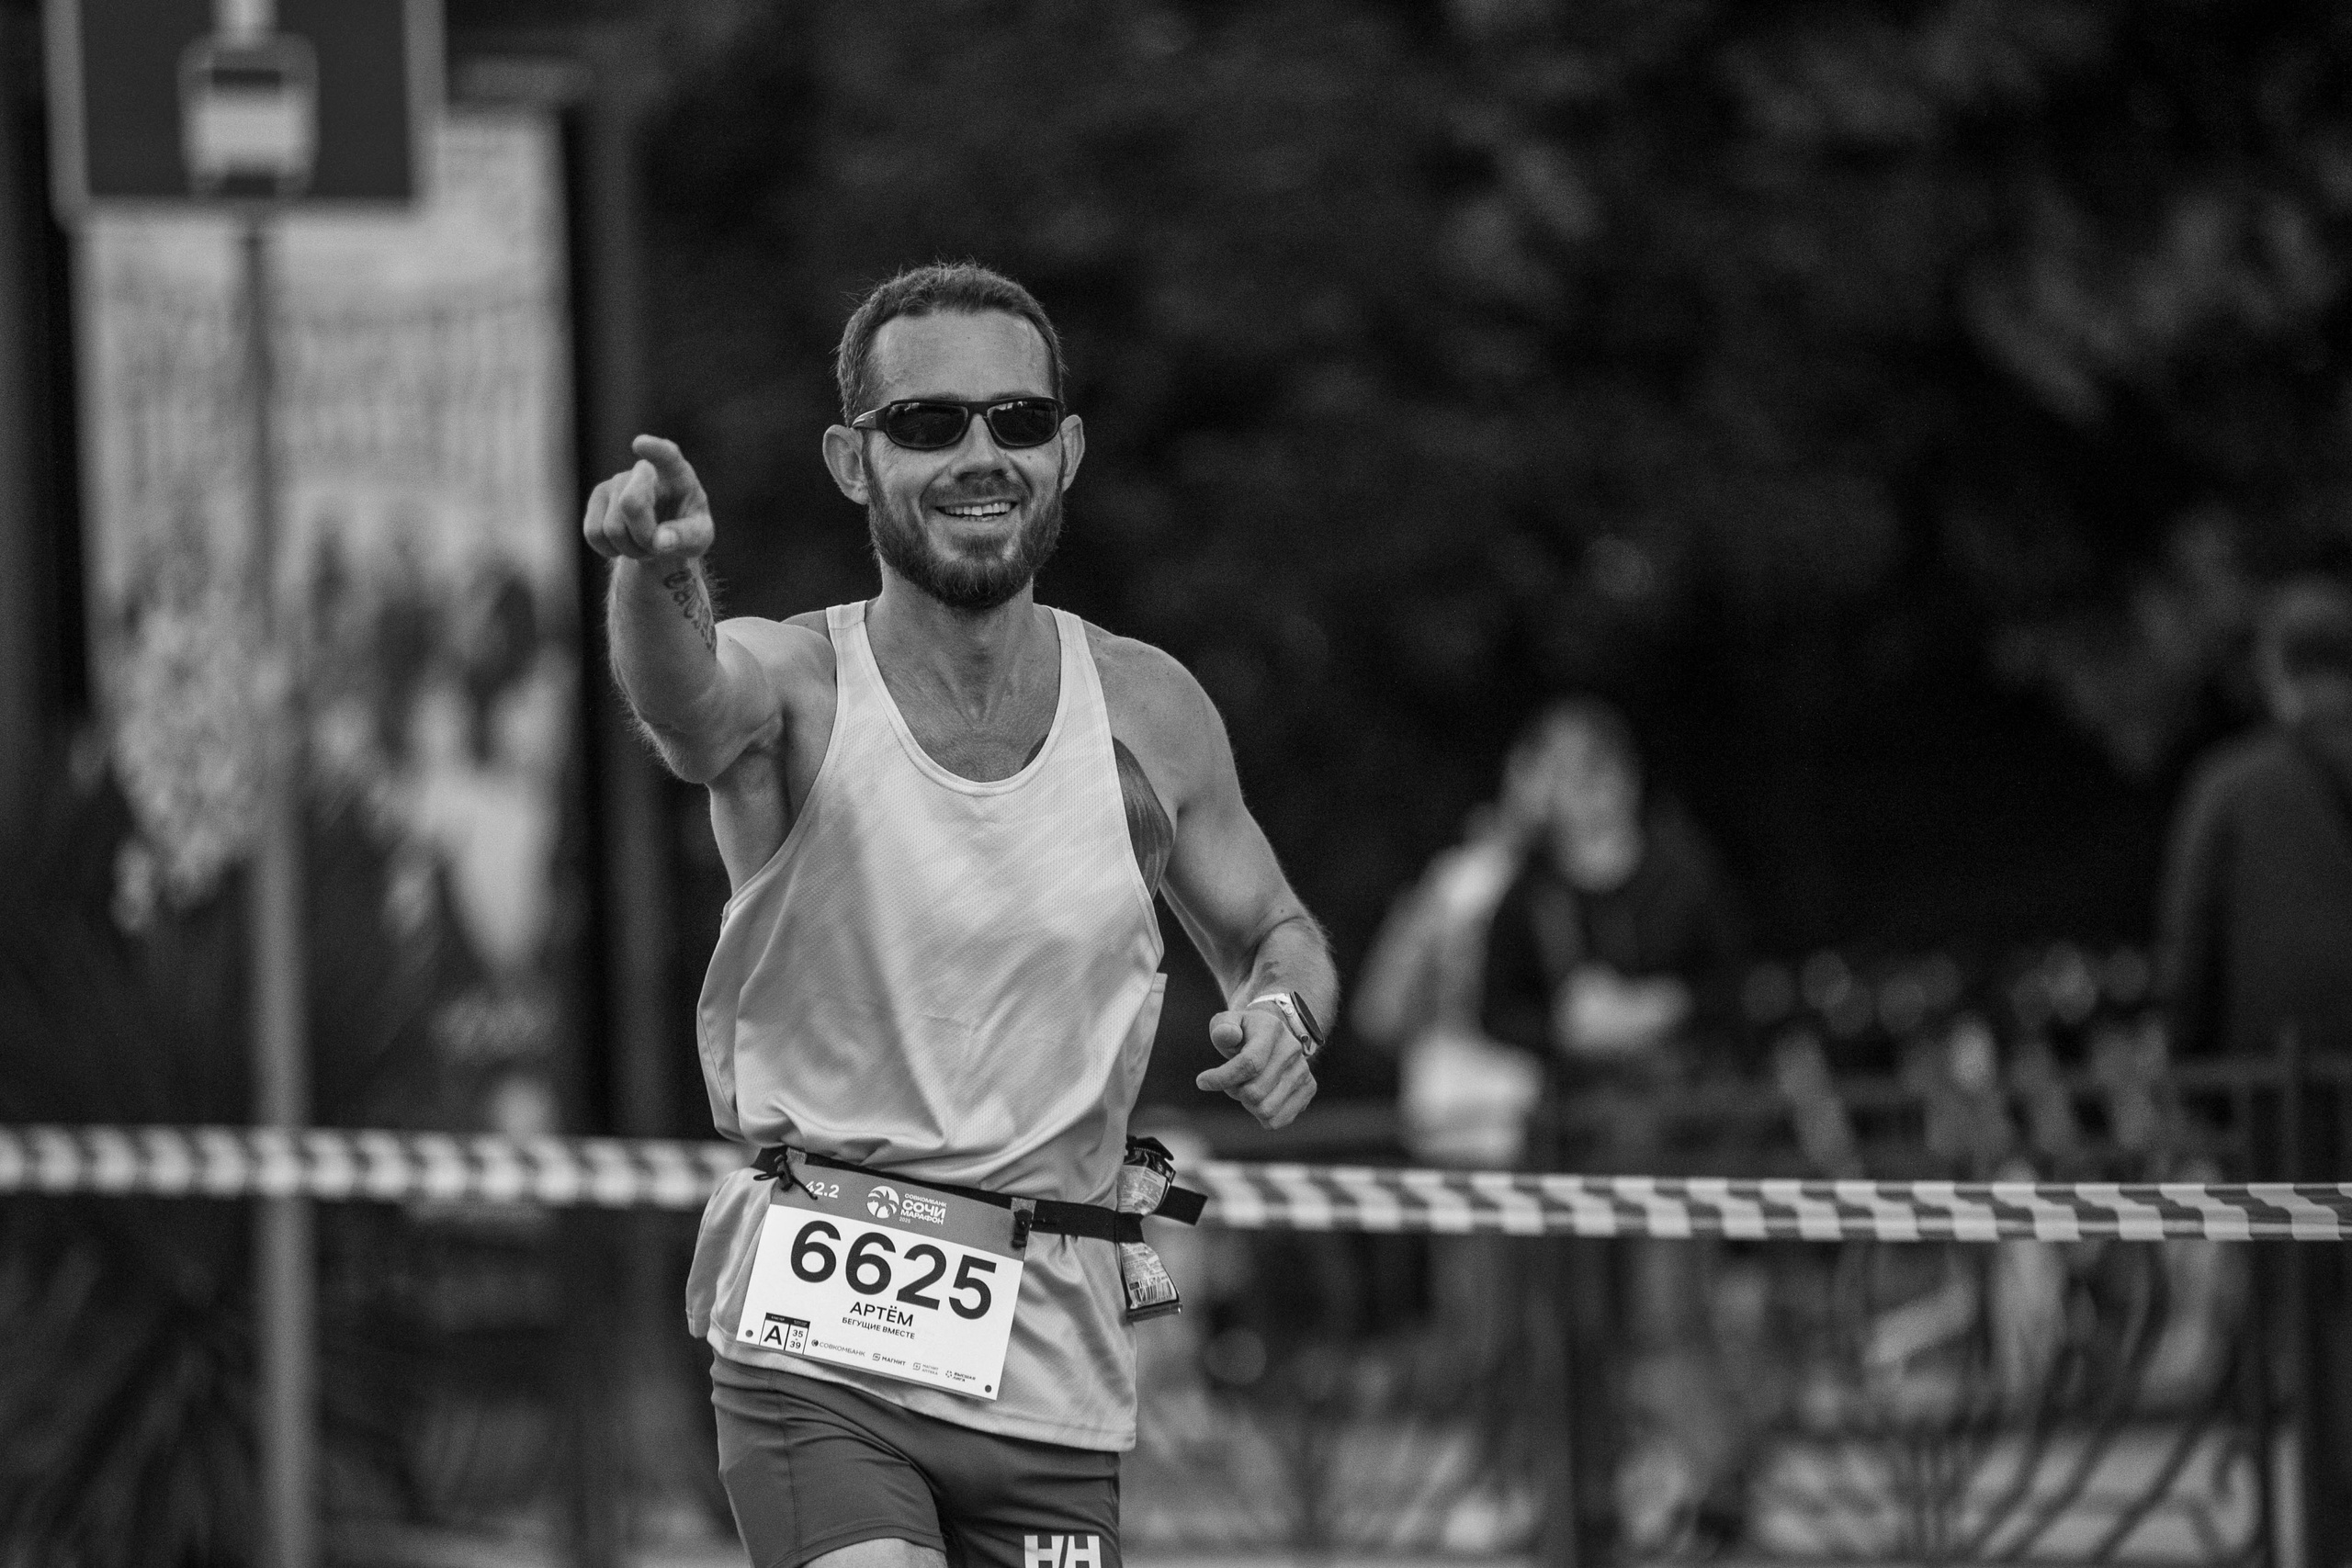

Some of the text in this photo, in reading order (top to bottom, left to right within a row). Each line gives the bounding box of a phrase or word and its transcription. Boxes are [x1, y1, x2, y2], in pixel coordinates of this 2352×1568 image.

[806, 1180, 840, 1199] 42.2
[904, 1193, 947, 1207] СОВКОМБАНК
[900, 1209, 944, 1225] МАРАФОН
[901, 1199, 946, 1219] СОЧИ
[790, 1220, 998, 1320] 6625
[850, 1301, 914, 1327] АРТЁМ
[792, 1329, 804, 1338] 35
[842, 1316, 916, 1340] БЕГУЩИЕ ВМЕСТЕ
[789, 1340, 801, 1349] 39
[819, 1341, 866, 1357] СОВКОМБАНК
[881, 1356, 906, 1367] МАГНИТ
